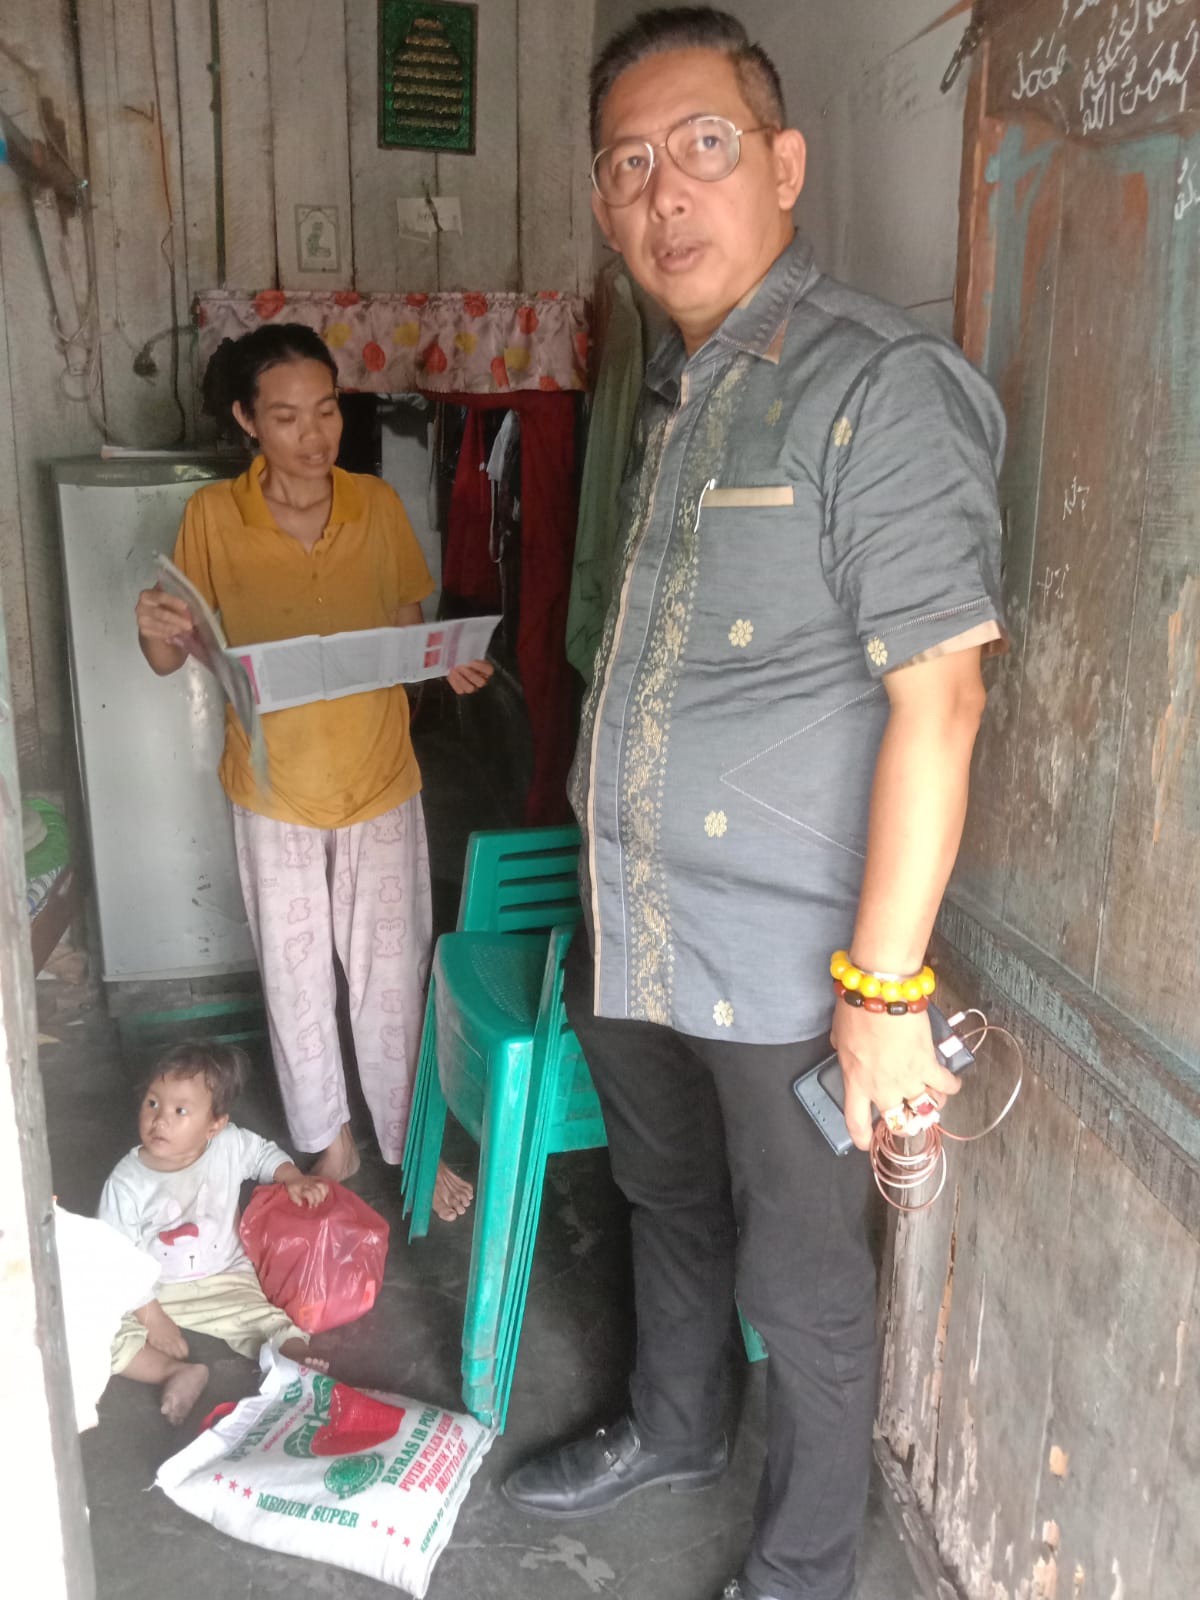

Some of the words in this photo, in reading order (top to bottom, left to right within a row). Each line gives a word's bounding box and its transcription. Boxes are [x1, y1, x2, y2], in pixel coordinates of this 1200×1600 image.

[381, 1440, 420, 1485] BERAS
[399, 1459, 427, 1492] PUTIH
[420, 1433, 444, 1462] PULEN
[418, 1449, 450, 1492] PRODUK
[256, 1492, 312, 1519] MEDIUM
[311, 1505, 360, 1528] SUPER
